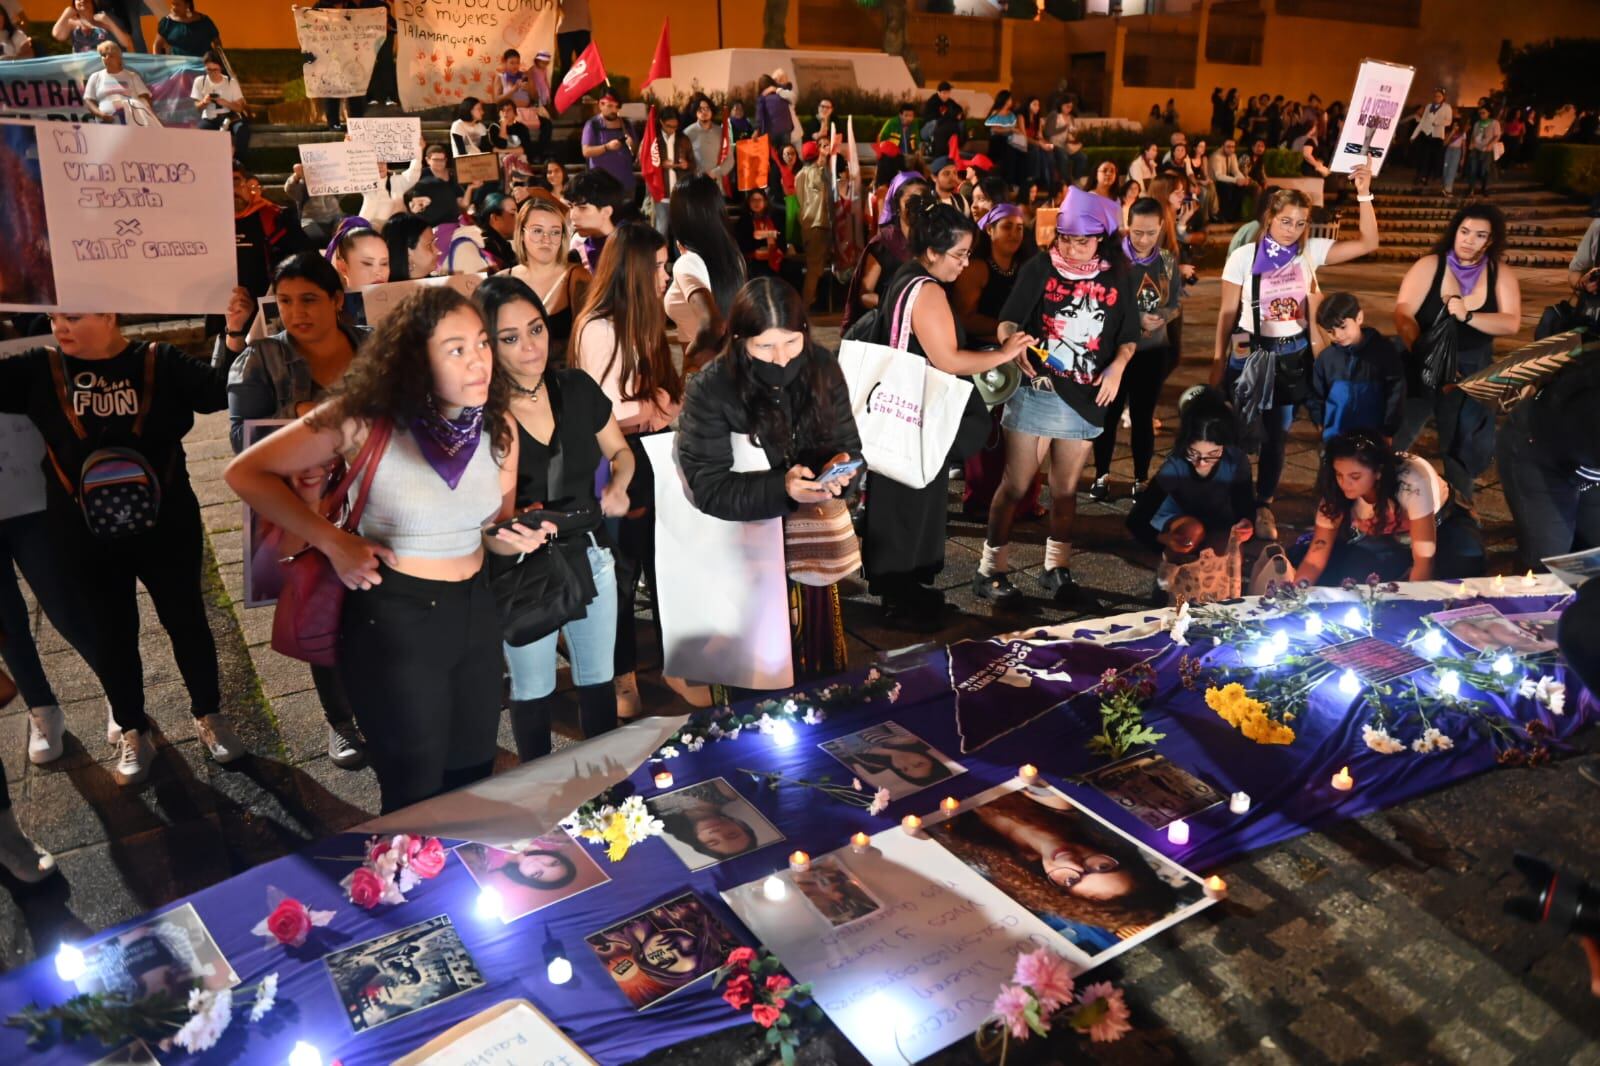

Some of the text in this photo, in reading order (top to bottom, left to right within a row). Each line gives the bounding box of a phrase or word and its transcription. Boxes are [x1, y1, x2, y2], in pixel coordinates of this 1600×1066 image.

[63, 161, 196, 184] UNA MENOS
[73, 388, 139, 417] FUN
